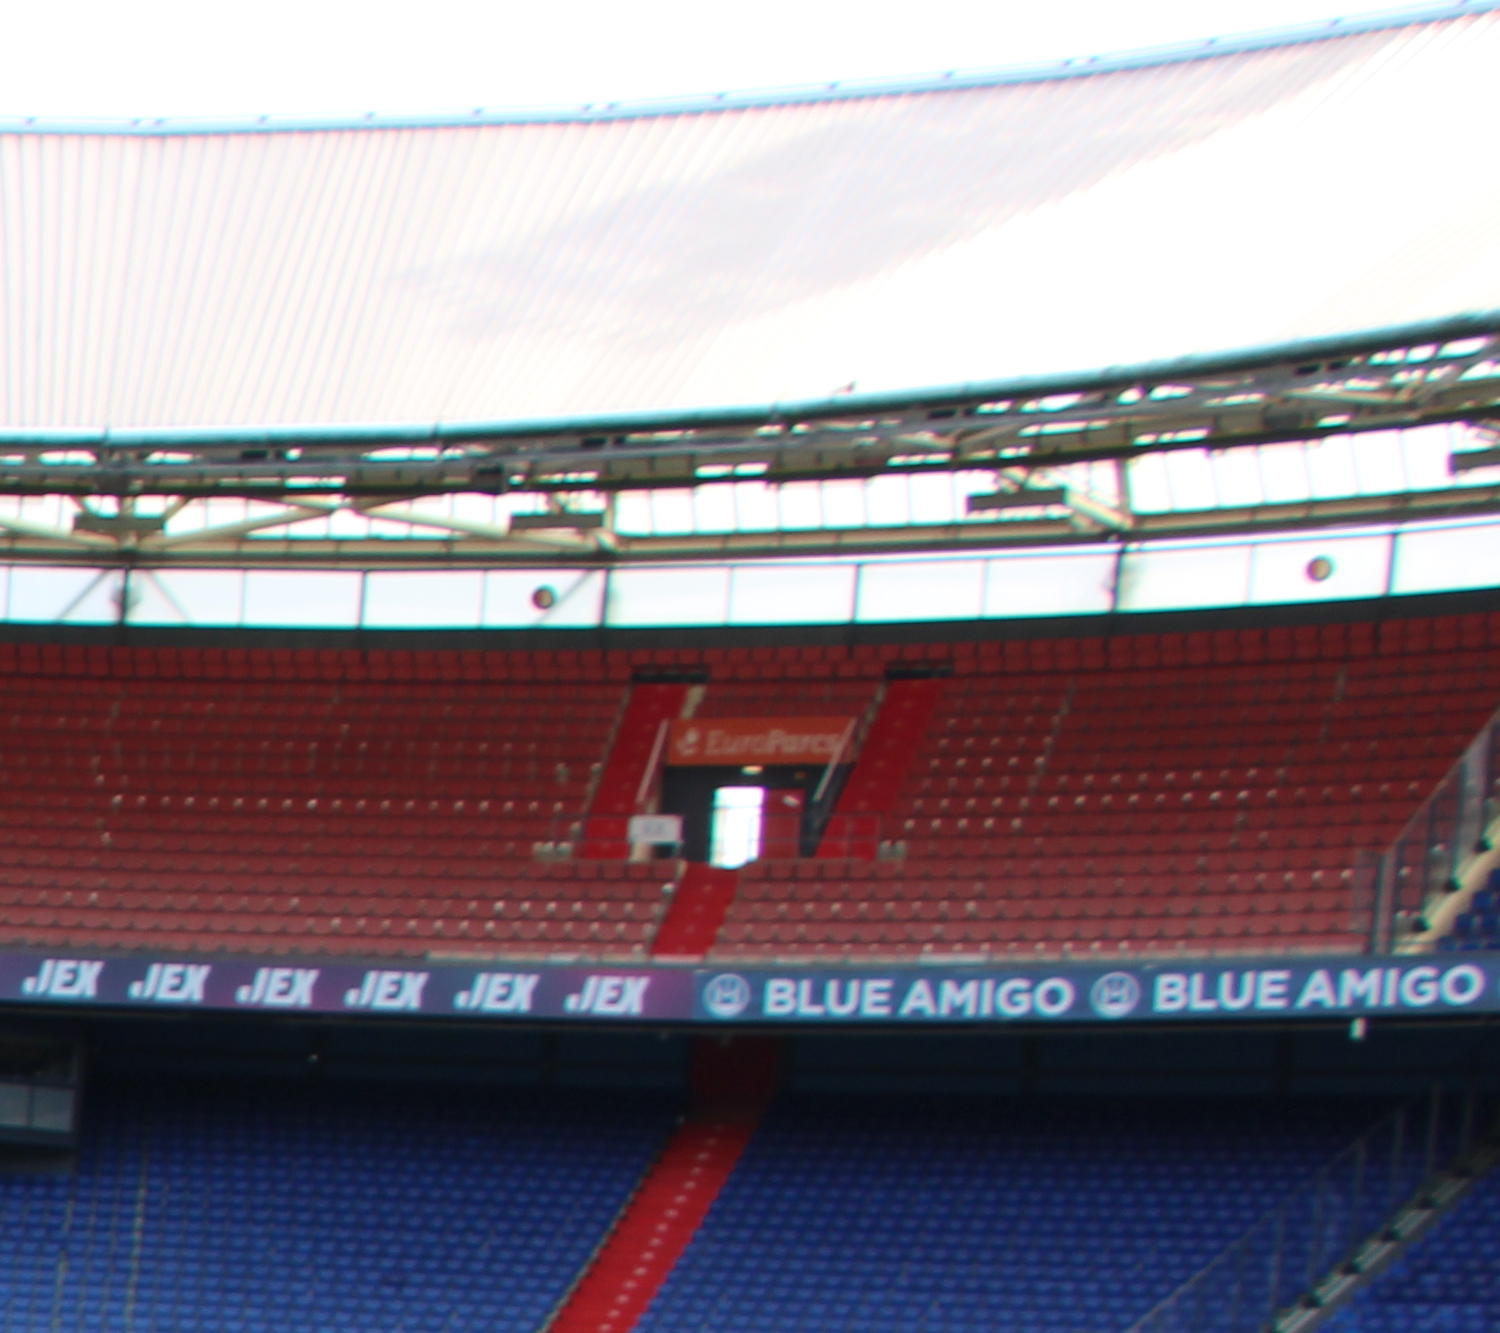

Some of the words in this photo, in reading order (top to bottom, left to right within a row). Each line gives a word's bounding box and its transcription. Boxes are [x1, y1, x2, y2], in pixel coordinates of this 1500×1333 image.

[21, 959, 105, 998] JEX
[128, 963, 212, 1003] JEX
[235, 967, 320, 1007] JEX
[344, 971, 429, 1010] JEX
[453, 973, 540, 1013] JEX
[563, 975, 651, 1016] JEX
[762, 978, 894, 1017] BLUE
[899, 977, 1074, 1018] AMIGO
[1151, 970, 1291, 1013] BLUE
[1294, 964, 1485, 1009] AMIGO
